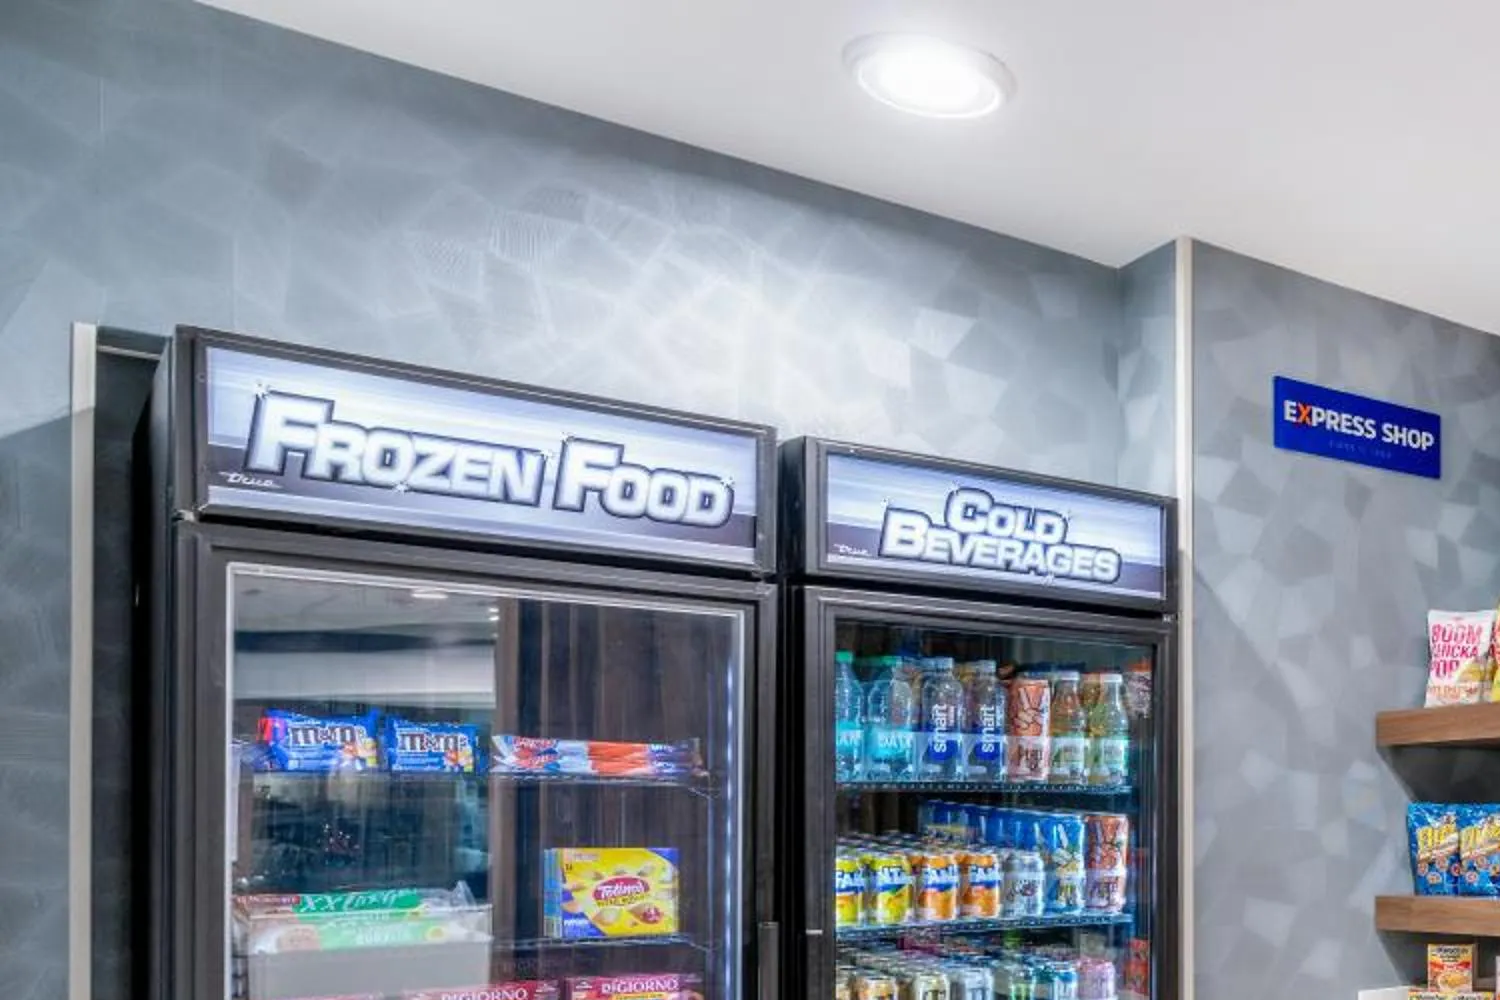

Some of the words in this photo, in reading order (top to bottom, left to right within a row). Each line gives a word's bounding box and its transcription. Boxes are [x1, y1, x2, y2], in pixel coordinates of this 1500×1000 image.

[1284, 400, 1377, 439] EXPRESS
[1382, 423, 1435, 451] SHOP
[244, 392, 546, 506] FROZEN
[553, 437, 734, 528] FOOD
[879, 508, 1122, 583] BEVERAGES
[945, 488, 1068, 544] COLD
